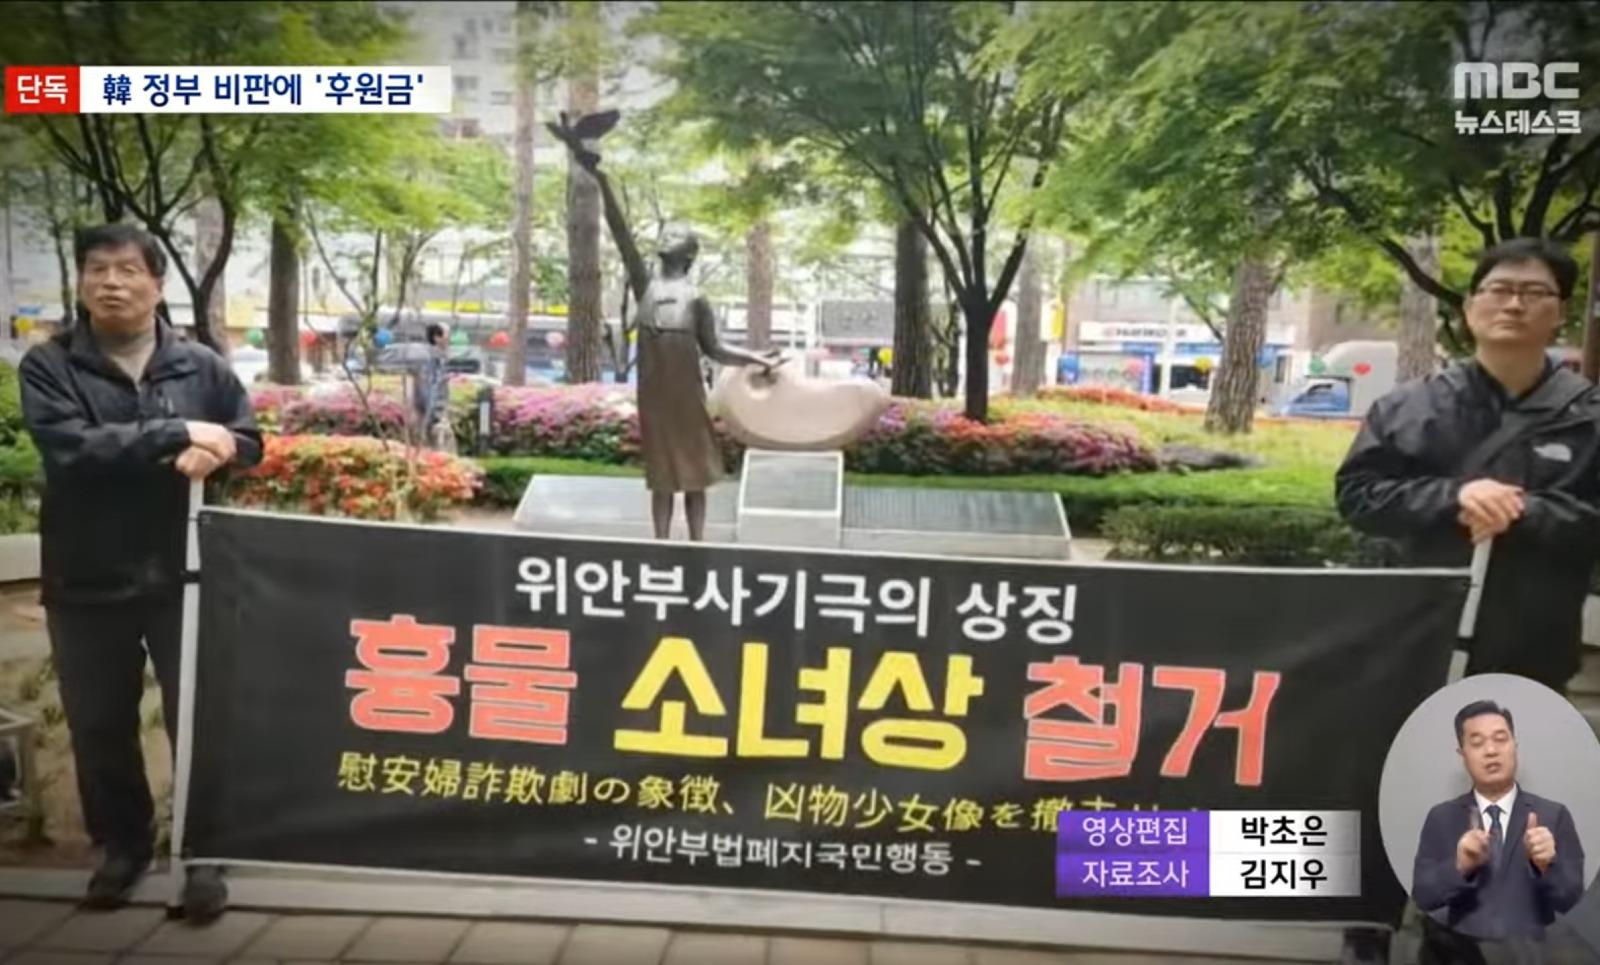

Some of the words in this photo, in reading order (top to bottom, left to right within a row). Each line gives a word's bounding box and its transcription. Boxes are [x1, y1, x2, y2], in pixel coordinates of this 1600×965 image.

[515, 556, 930, 638] 위안부사기극의
[956, 581, 1078, 644] 상징
[345, 614, 578, 746] 흉물
[613, 636, 984, 771] 소녀상
[1024, 655, 1281, 787] 철거
[609, 823, 953, 876] 위안부법폐지국민행동
